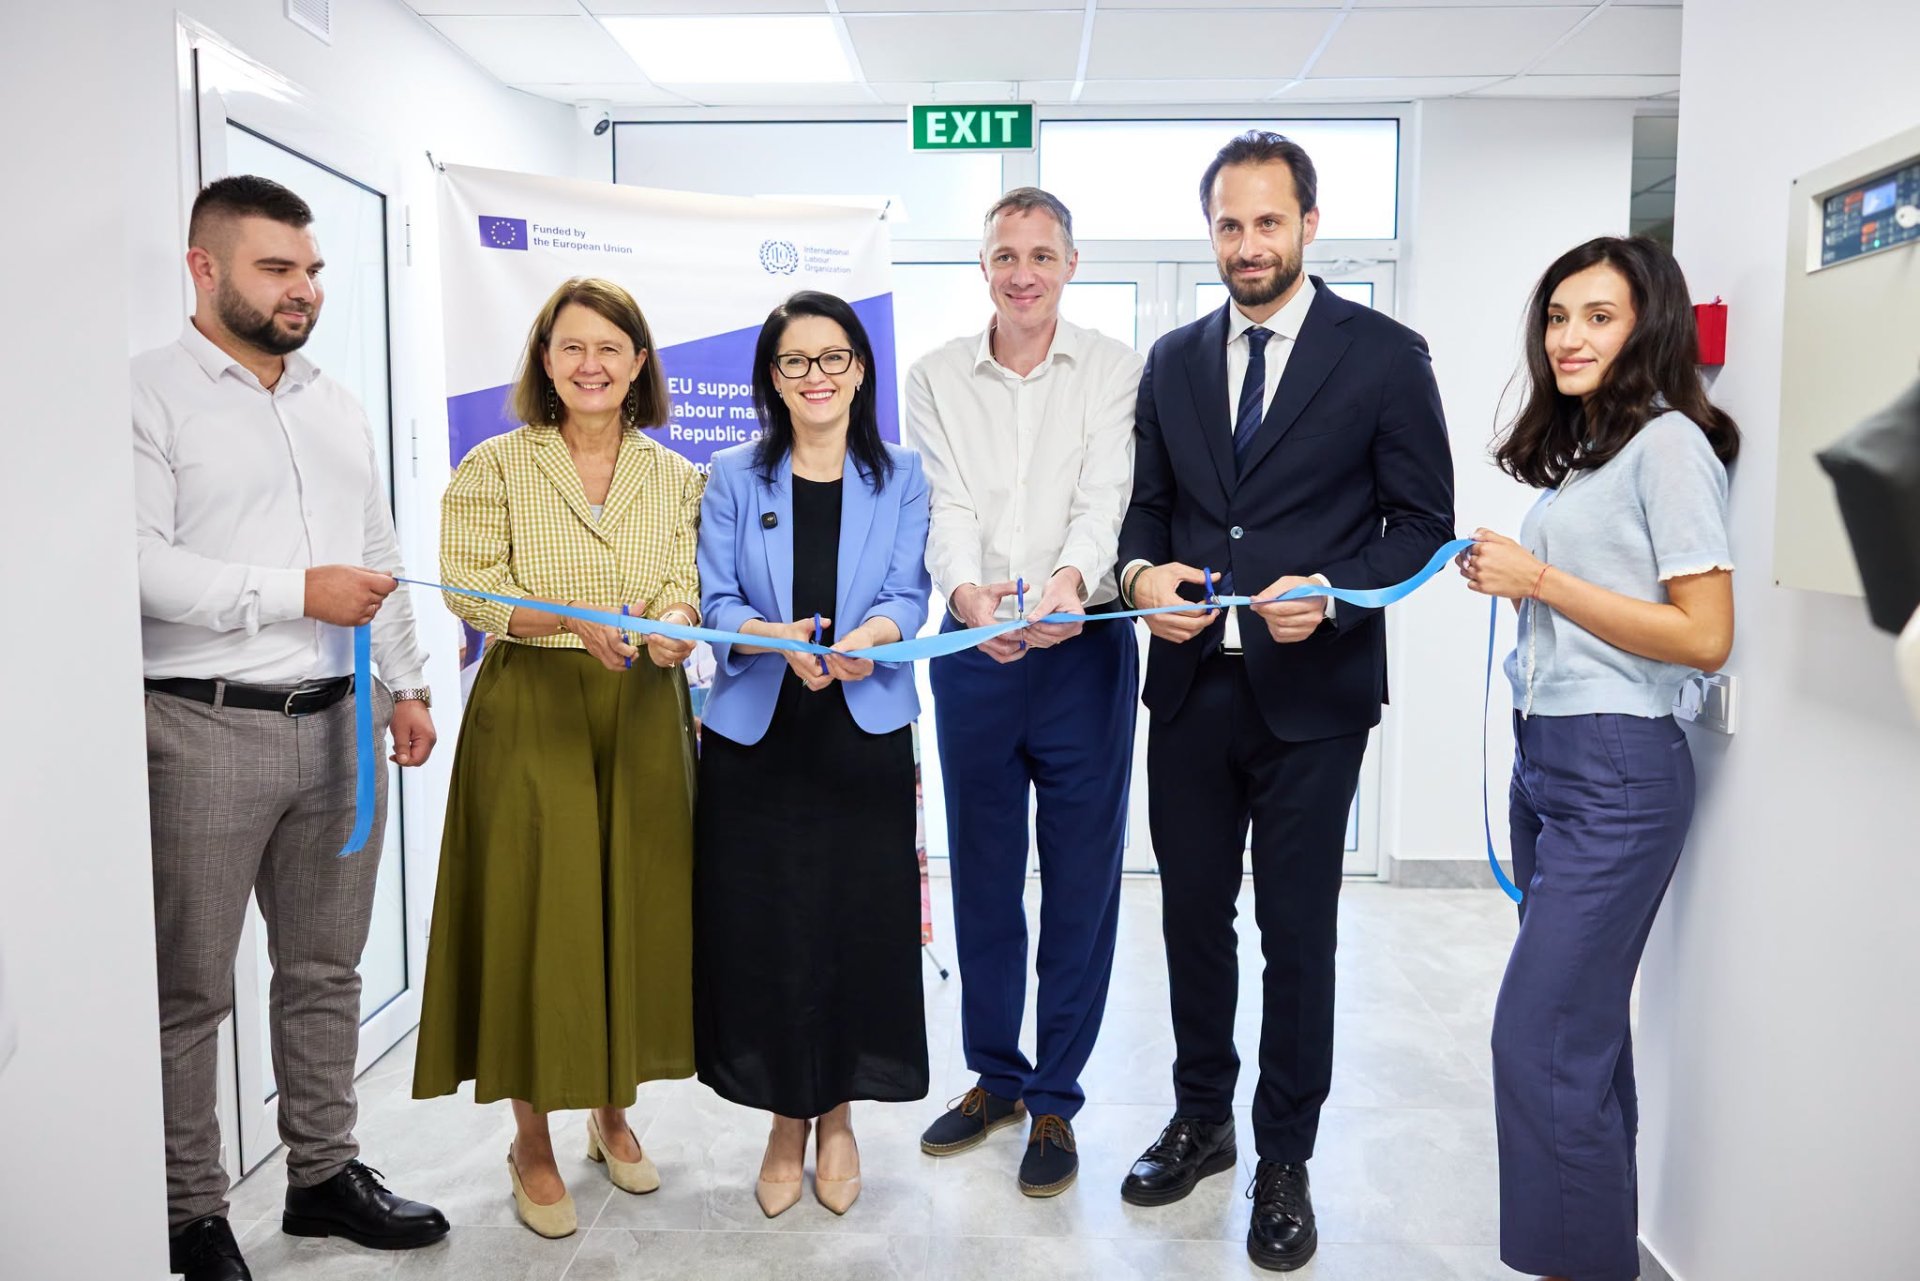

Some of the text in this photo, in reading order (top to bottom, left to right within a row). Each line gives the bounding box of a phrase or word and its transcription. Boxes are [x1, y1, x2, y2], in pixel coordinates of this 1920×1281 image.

[926, 111, 1019, 143] EXIT
[533, 224, 586, 239] Funded by
[533, 237, 633, 253] the European Union
[804, 246, 849, 255] International
[804, 255, 830, 263] Labour
[804, 263, 851, 273] Organization
[668, 378, 692, 394] EU
[670, 424, 746, 444] Republic
